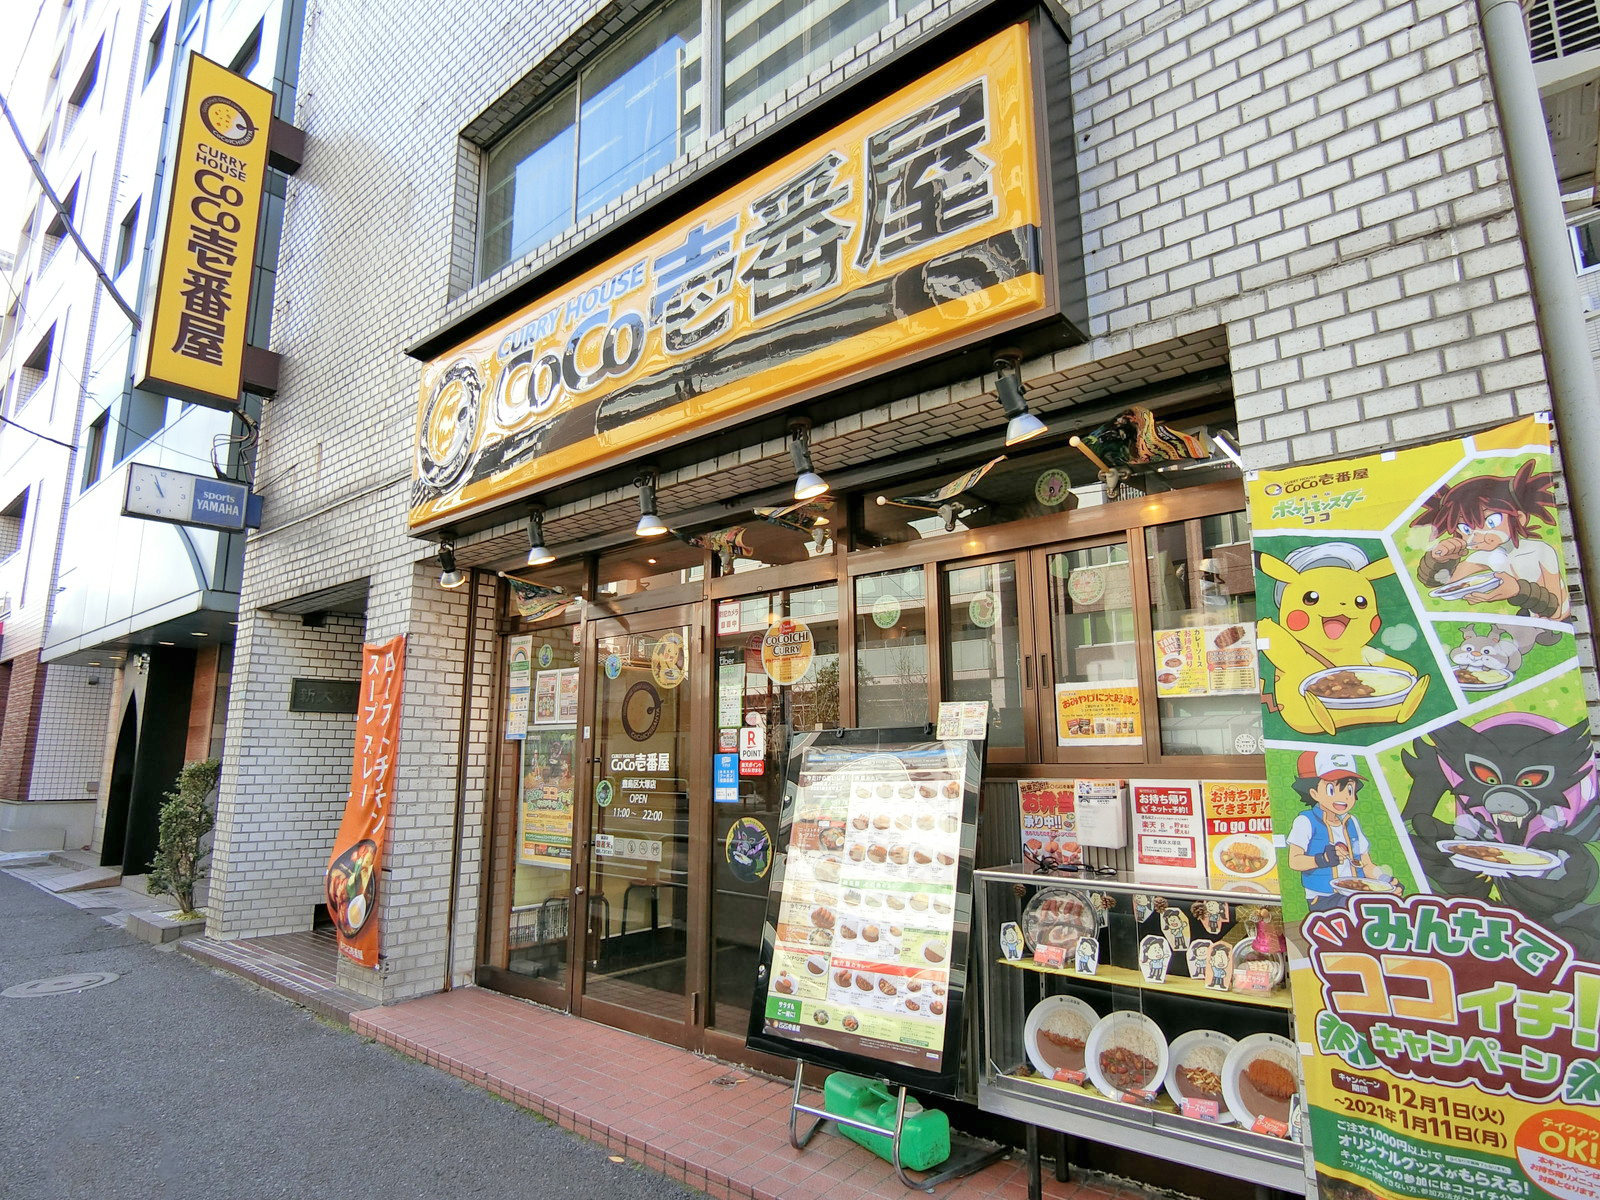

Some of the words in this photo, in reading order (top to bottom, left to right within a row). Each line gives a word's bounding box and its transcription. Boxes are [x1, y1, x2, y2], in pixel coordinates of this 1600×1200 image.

[196, 152, 247, 183] HOUSE
[198, 143, 247, 171] CURRY
[495, 76, 998, 426] CoCo壱番屋
[498, 307, 560, 358] CURRY
[564, 260, 648, 324] HOUSE
[1285, 468, 1369, 494] CoCo壱番屋
[197, 499, 239, 517] YAMAHA
[203, 491, 236, 504] sports
[1303, 512, 1330, 525] ココ
[747, 731, 756, 746] R
[611, 753, 670, 771] CoCo壱番屋
[629, 794, 648, 804] OPEN
[1022, 791, 1075, 815] お弁当
[1139, 794, 1188, 805] お持ち帰り
[1210, 788, 1270, 803] お持ち帰り
[642, 810, 663, 822] 22:00
[1142, 821, 1157, 829] 楽天
[1213, 819, 1228, 833] To
[1230, 821, 1246, 834] go
[1248, 818, 1273, 833] OK!!
[1361, 904, 1560, 977] みんなで
[1320, 953, 1600, 1051] ココイチ!
[1370, 1023, 1561, 1084] キャンペーン
[1338, 1073, 1381, 1088] キャンペーン
[1351, 1083, 1369, 1095] 期間
[1391, 1084, 1505, 1126] 12月1日(火)
[1338, 1134, 1529, 1195] オリジナルグッズがもらえる!
[1340, 1150, 1525, 1200] キャンペーンの参加にはココイチ公
[1538, 1175, 1600, 1199] 対象となります。
